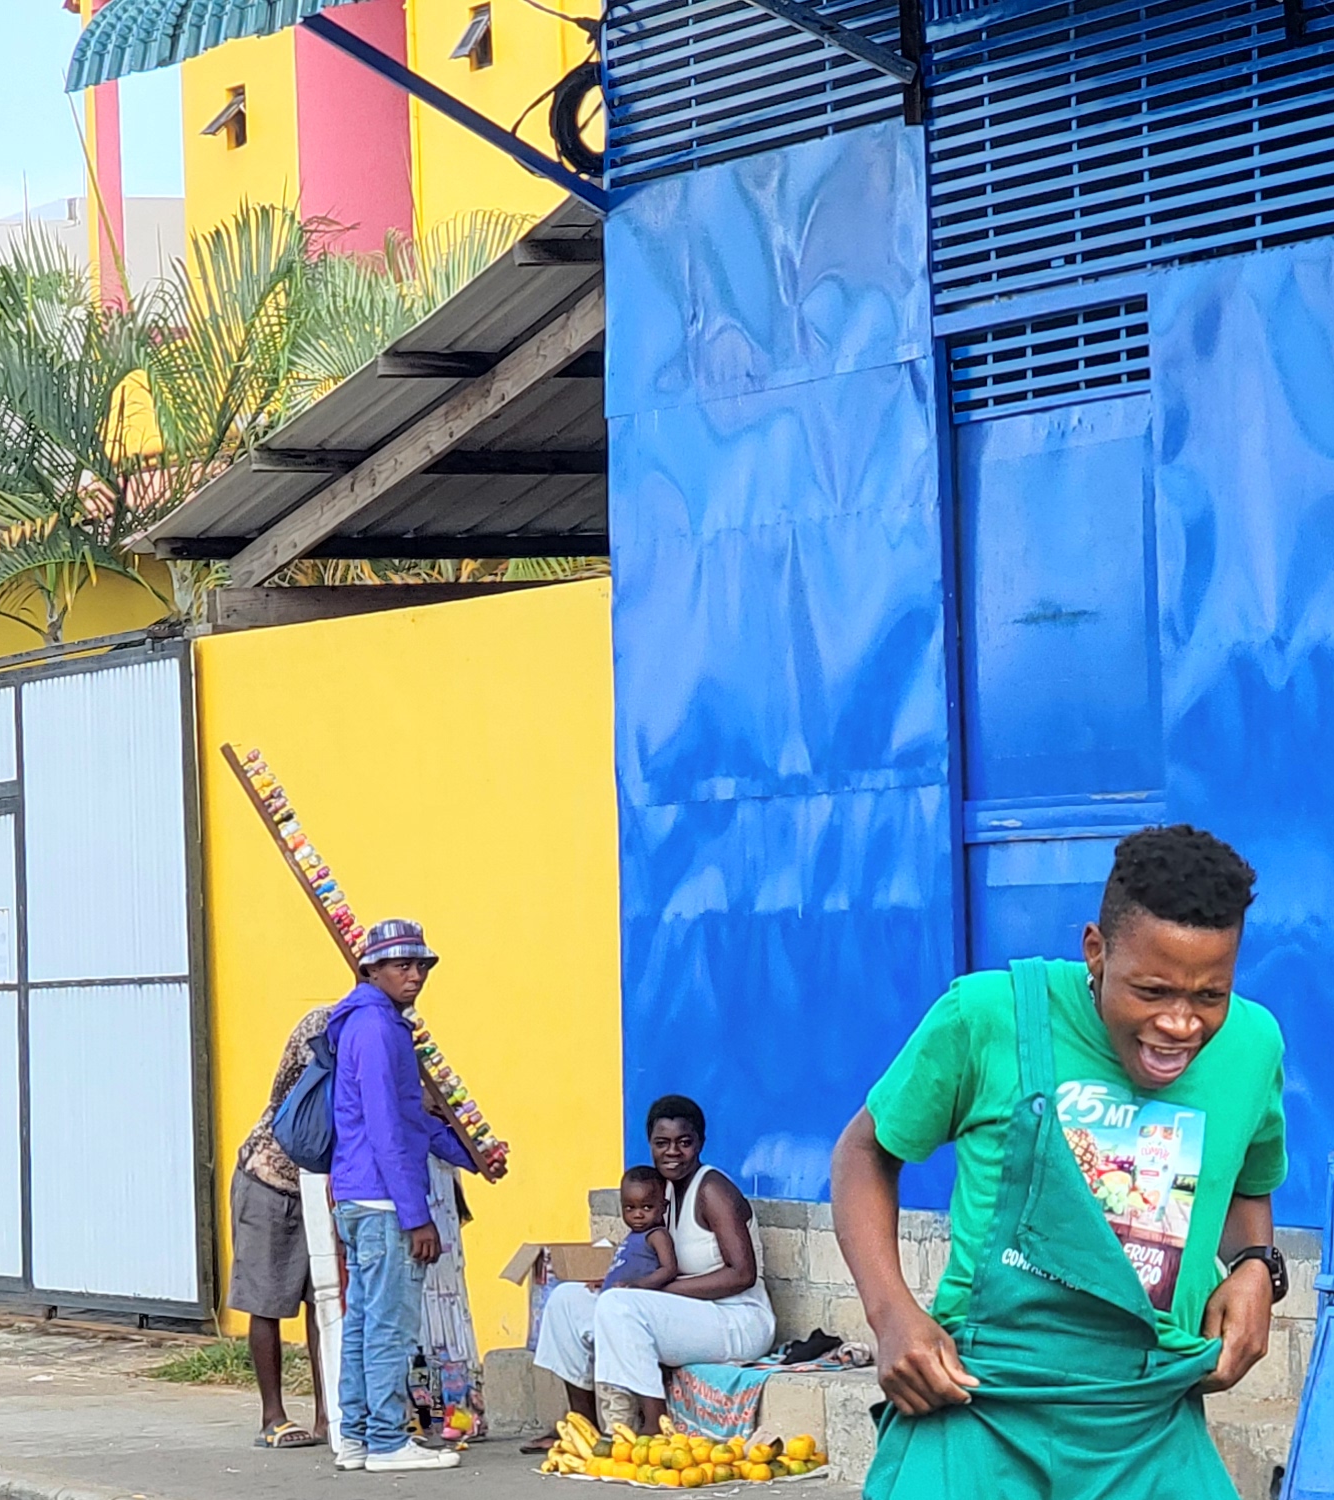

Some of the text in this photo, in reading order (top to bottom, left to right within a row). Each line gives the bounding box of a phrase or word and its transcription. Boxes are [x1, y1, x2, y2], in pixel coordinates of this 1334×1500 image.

[1056, 1081, 1108, 1124] 25
[1103, 1103, 1139, 1129] MT
[1123, 1243, 1165, 1267] FRUTA
